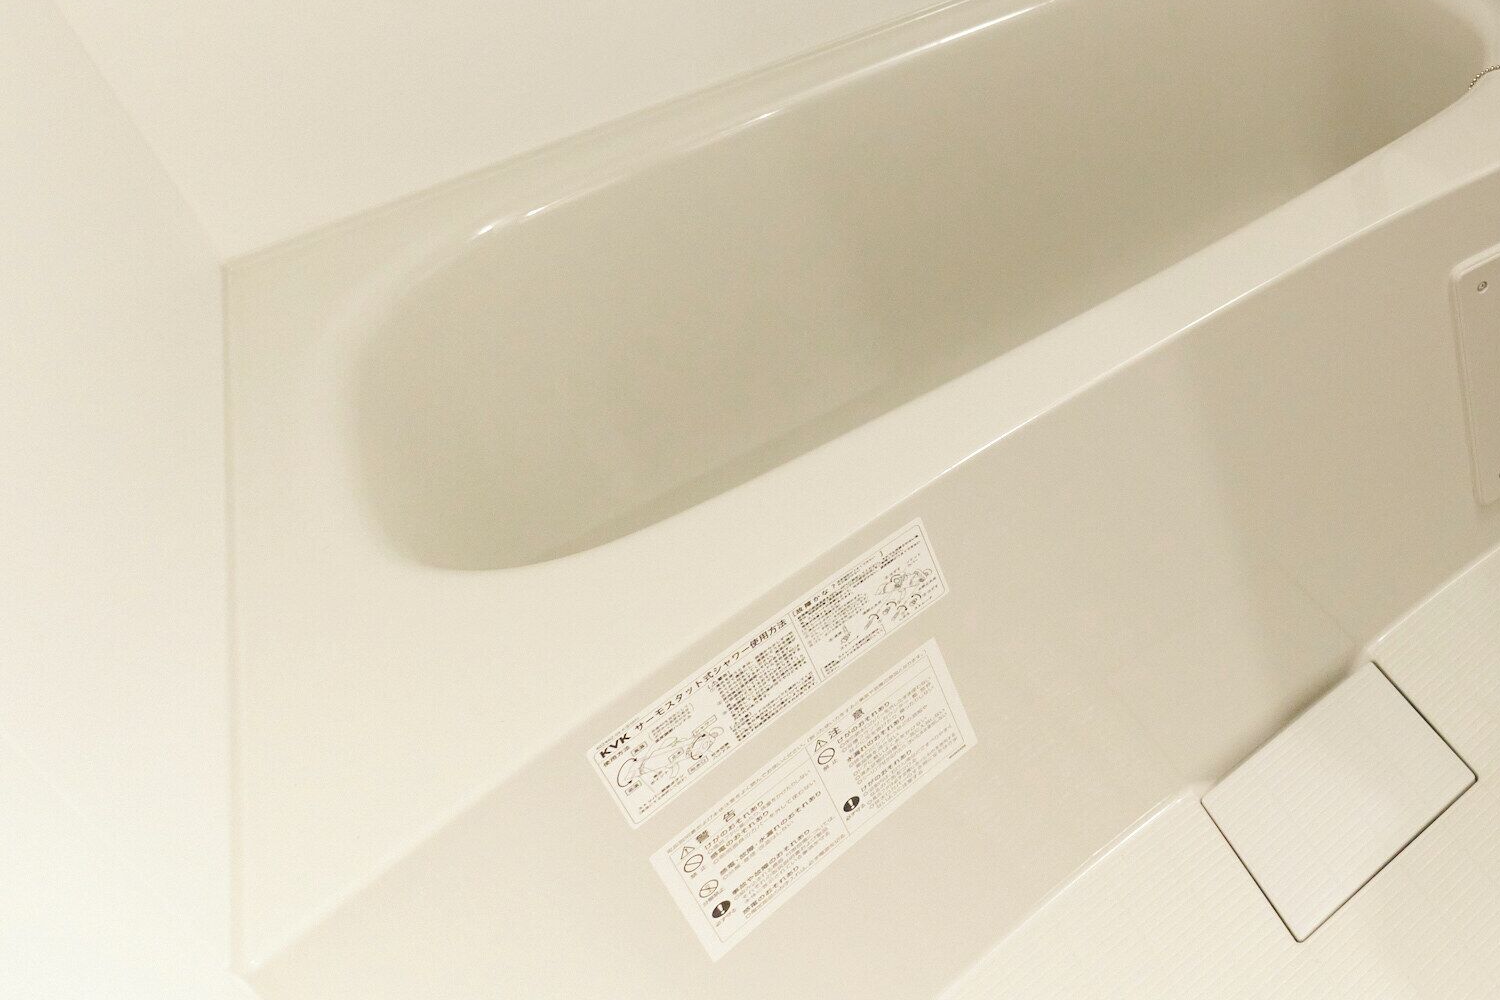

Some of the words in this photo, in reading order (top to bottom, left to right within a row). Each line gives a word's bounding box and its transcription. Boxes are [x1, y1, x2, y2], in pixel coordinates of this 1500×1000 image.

[598, 732, 631, 759] KVK
[633, 617, 787, 732] サーモスタット式シャワー使用方法
[827, 706, 865, 740] 注意
[836, 699, 890, 744] けがのおそれあり
[846, 713, 905, 763] 水漏れのおそれあり
[860, 748, 912, 793] けがのおそれあり
[694, 807, 737, 845] 警告
[703, 799, 765, 850] けがのおそれあり
[709, 808, 770, 860] 感電のおそれあり
[730, 827, 811, 895] 事故や故障のおそれあり
[741, 864, 800, 915] 感電のおそれあり
